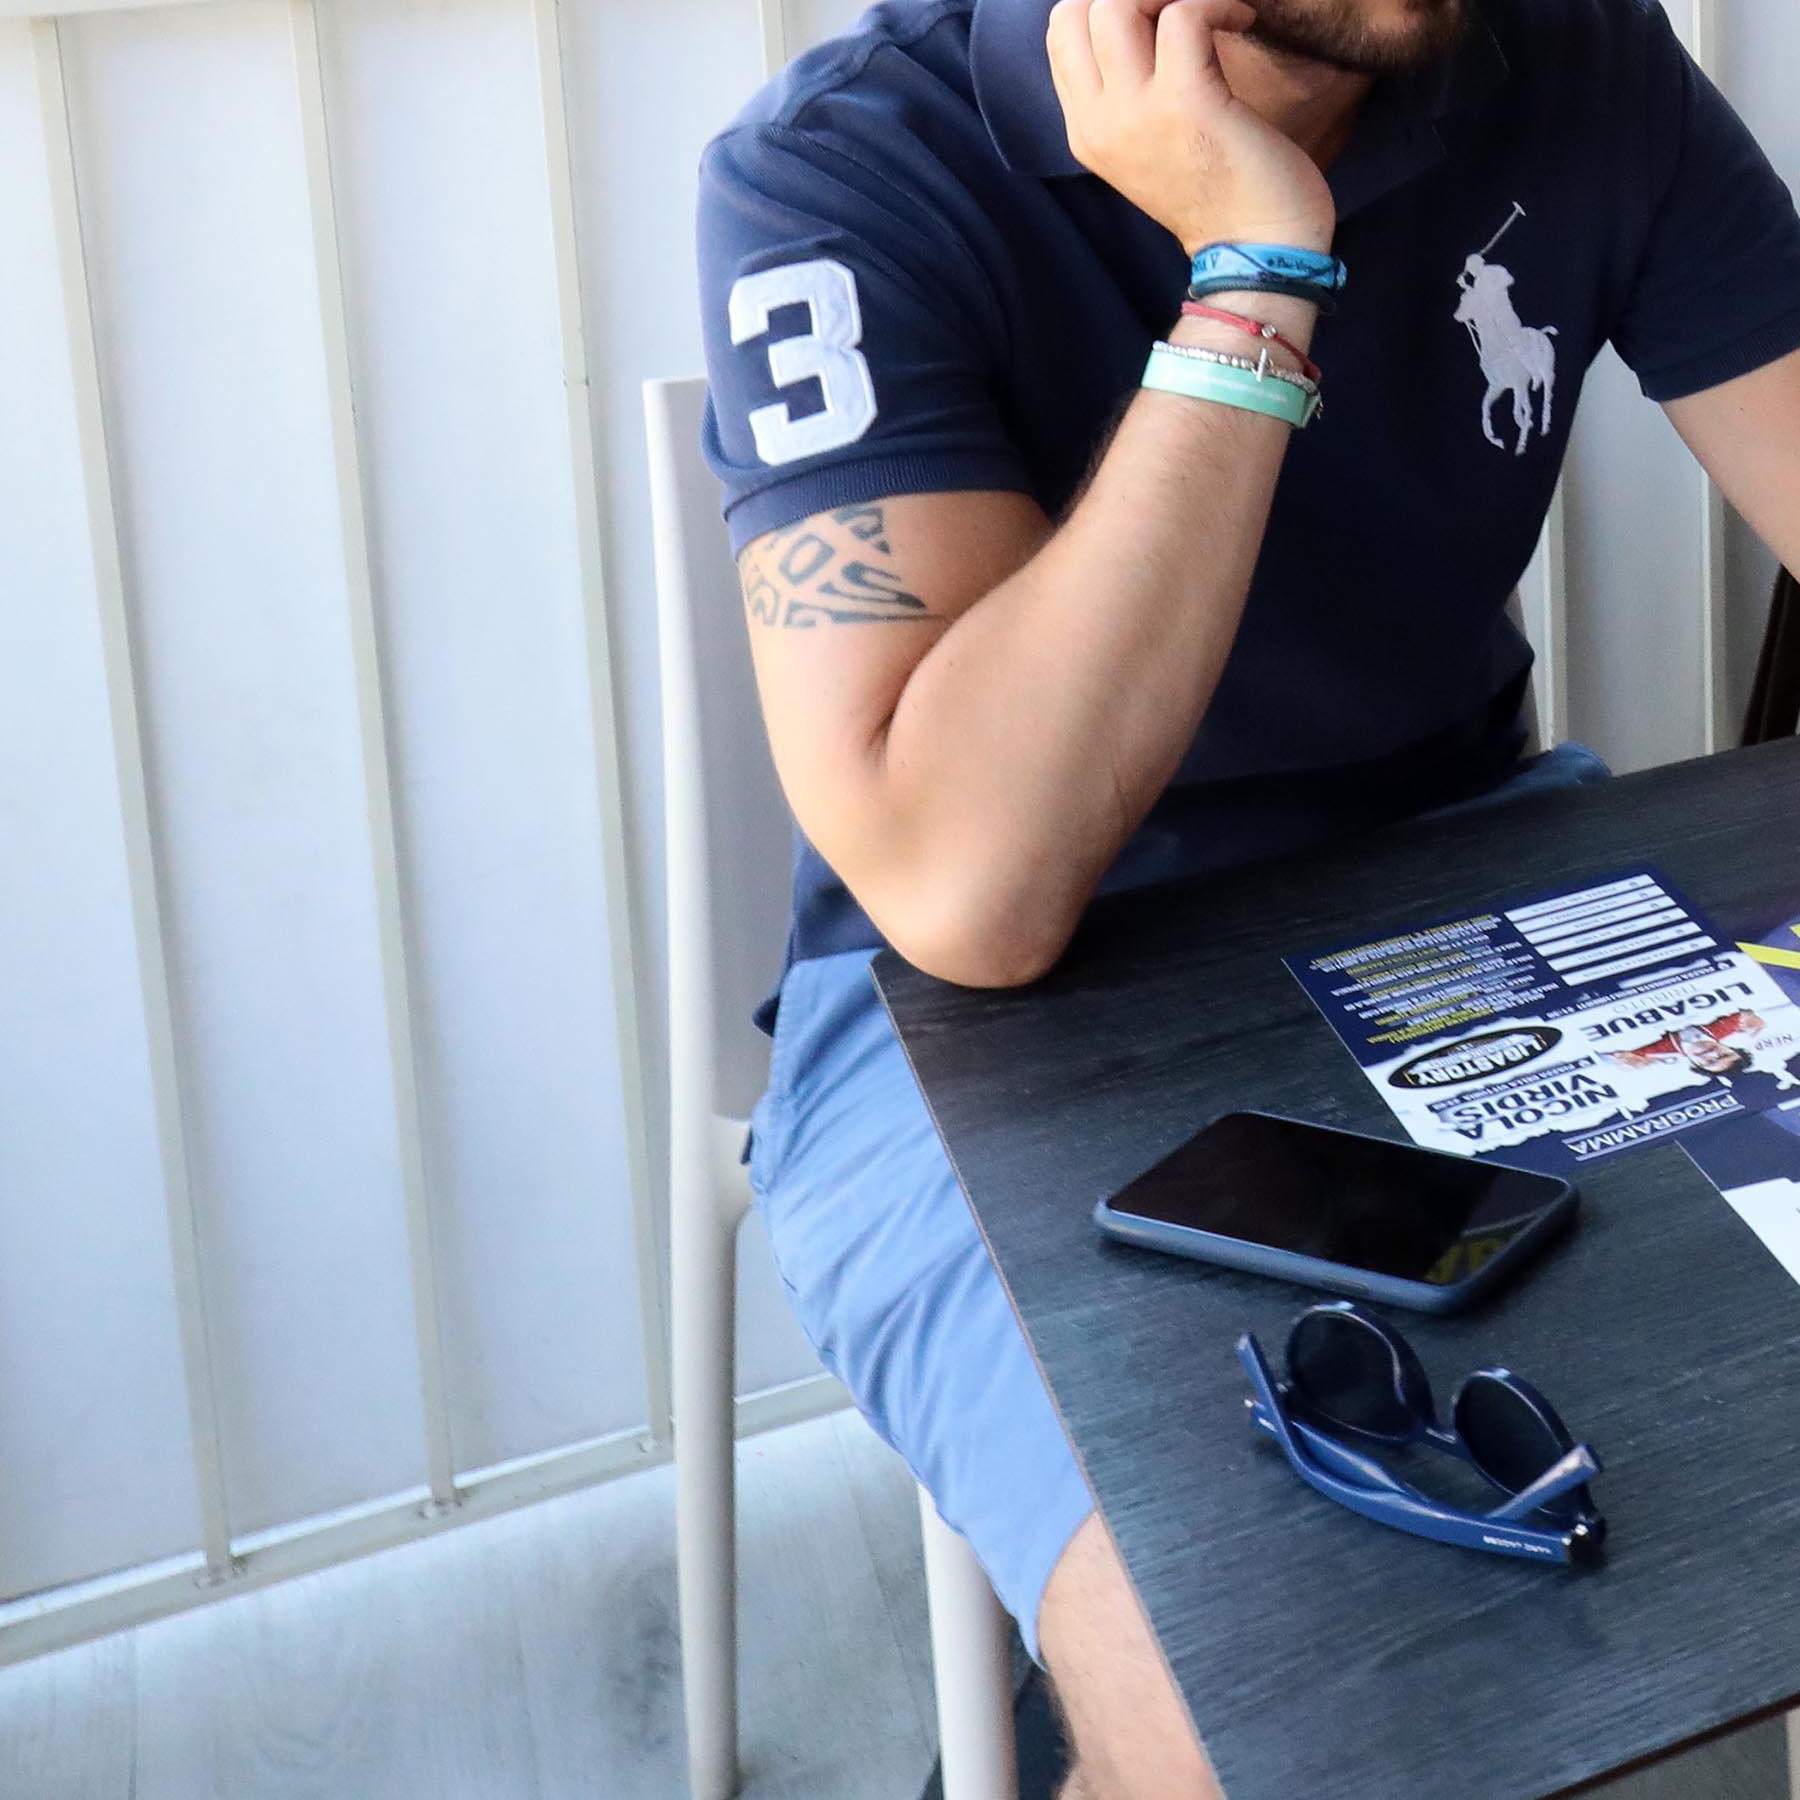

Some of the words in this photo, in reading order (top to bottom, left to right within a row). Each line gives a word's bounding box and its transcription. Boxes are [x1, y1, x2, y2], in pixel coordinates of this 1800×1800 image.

[728, 258, 878, 466] 3
[1580, 982, 1755, 1042] LIGABUE
[1450, 1073, 1601, 1124] VIRDIS
[1452, 1084, 1619, 1140] NICOLA
[1569, 1095, 1739, 1159] PROGRAMMA
